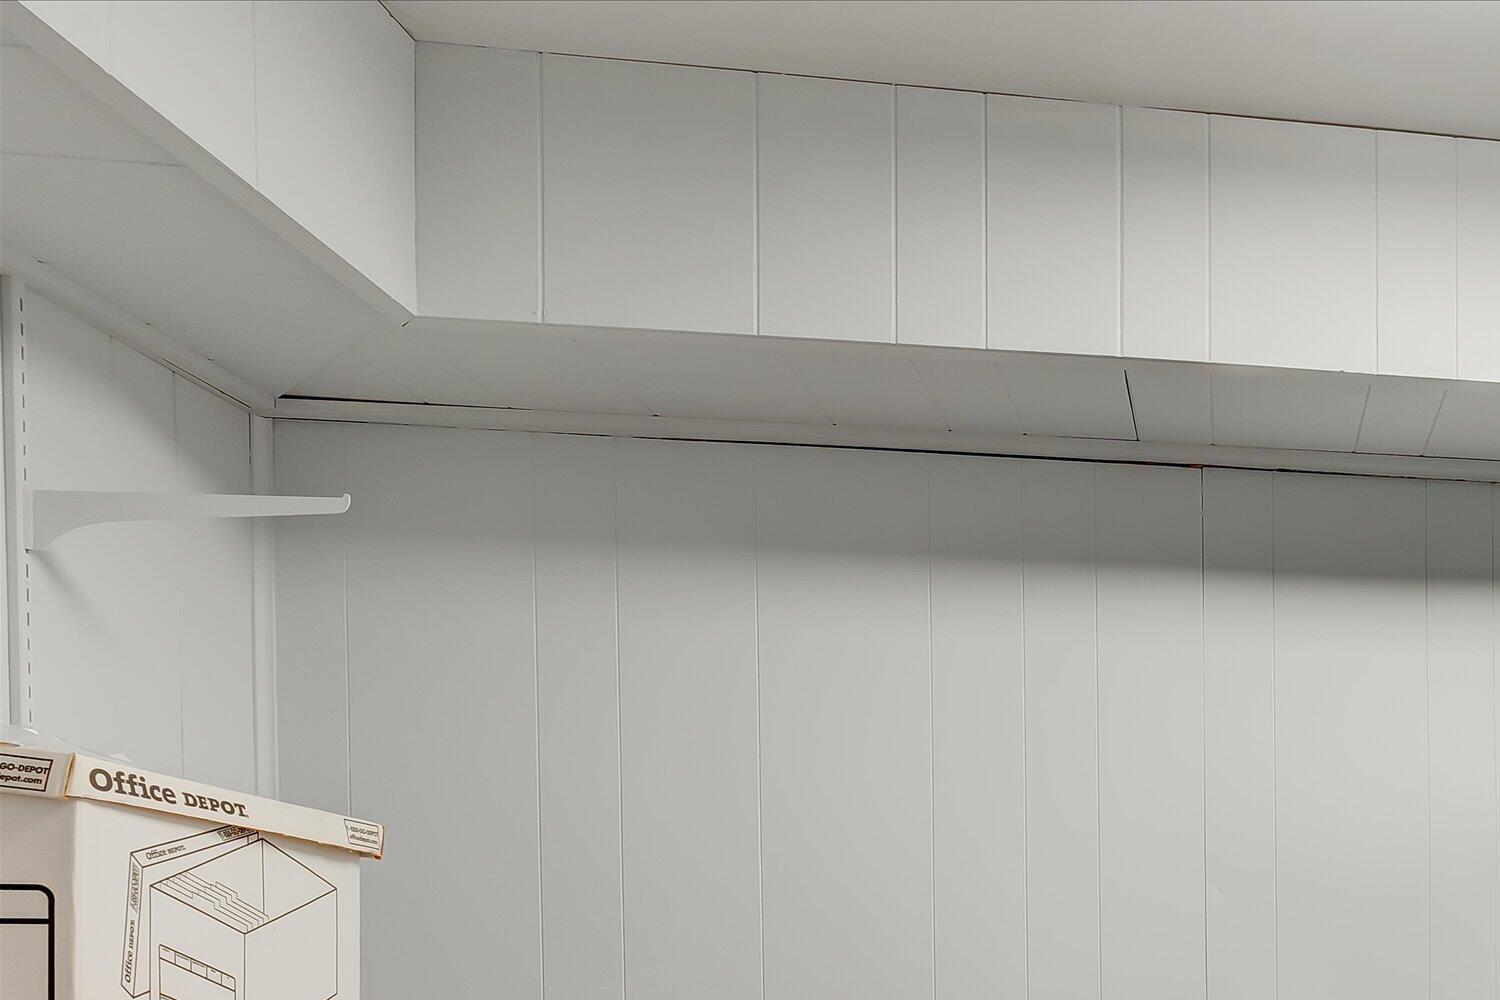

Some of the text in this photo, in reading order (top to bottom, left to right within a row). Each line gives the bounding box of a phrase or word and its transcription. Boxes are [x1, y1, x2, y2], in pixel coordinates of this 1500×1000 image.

[0, 774, 43, 785] epot.com
[89, 768, 247, 818] Office DEPOT
[124, 951, 134, 984] Office
